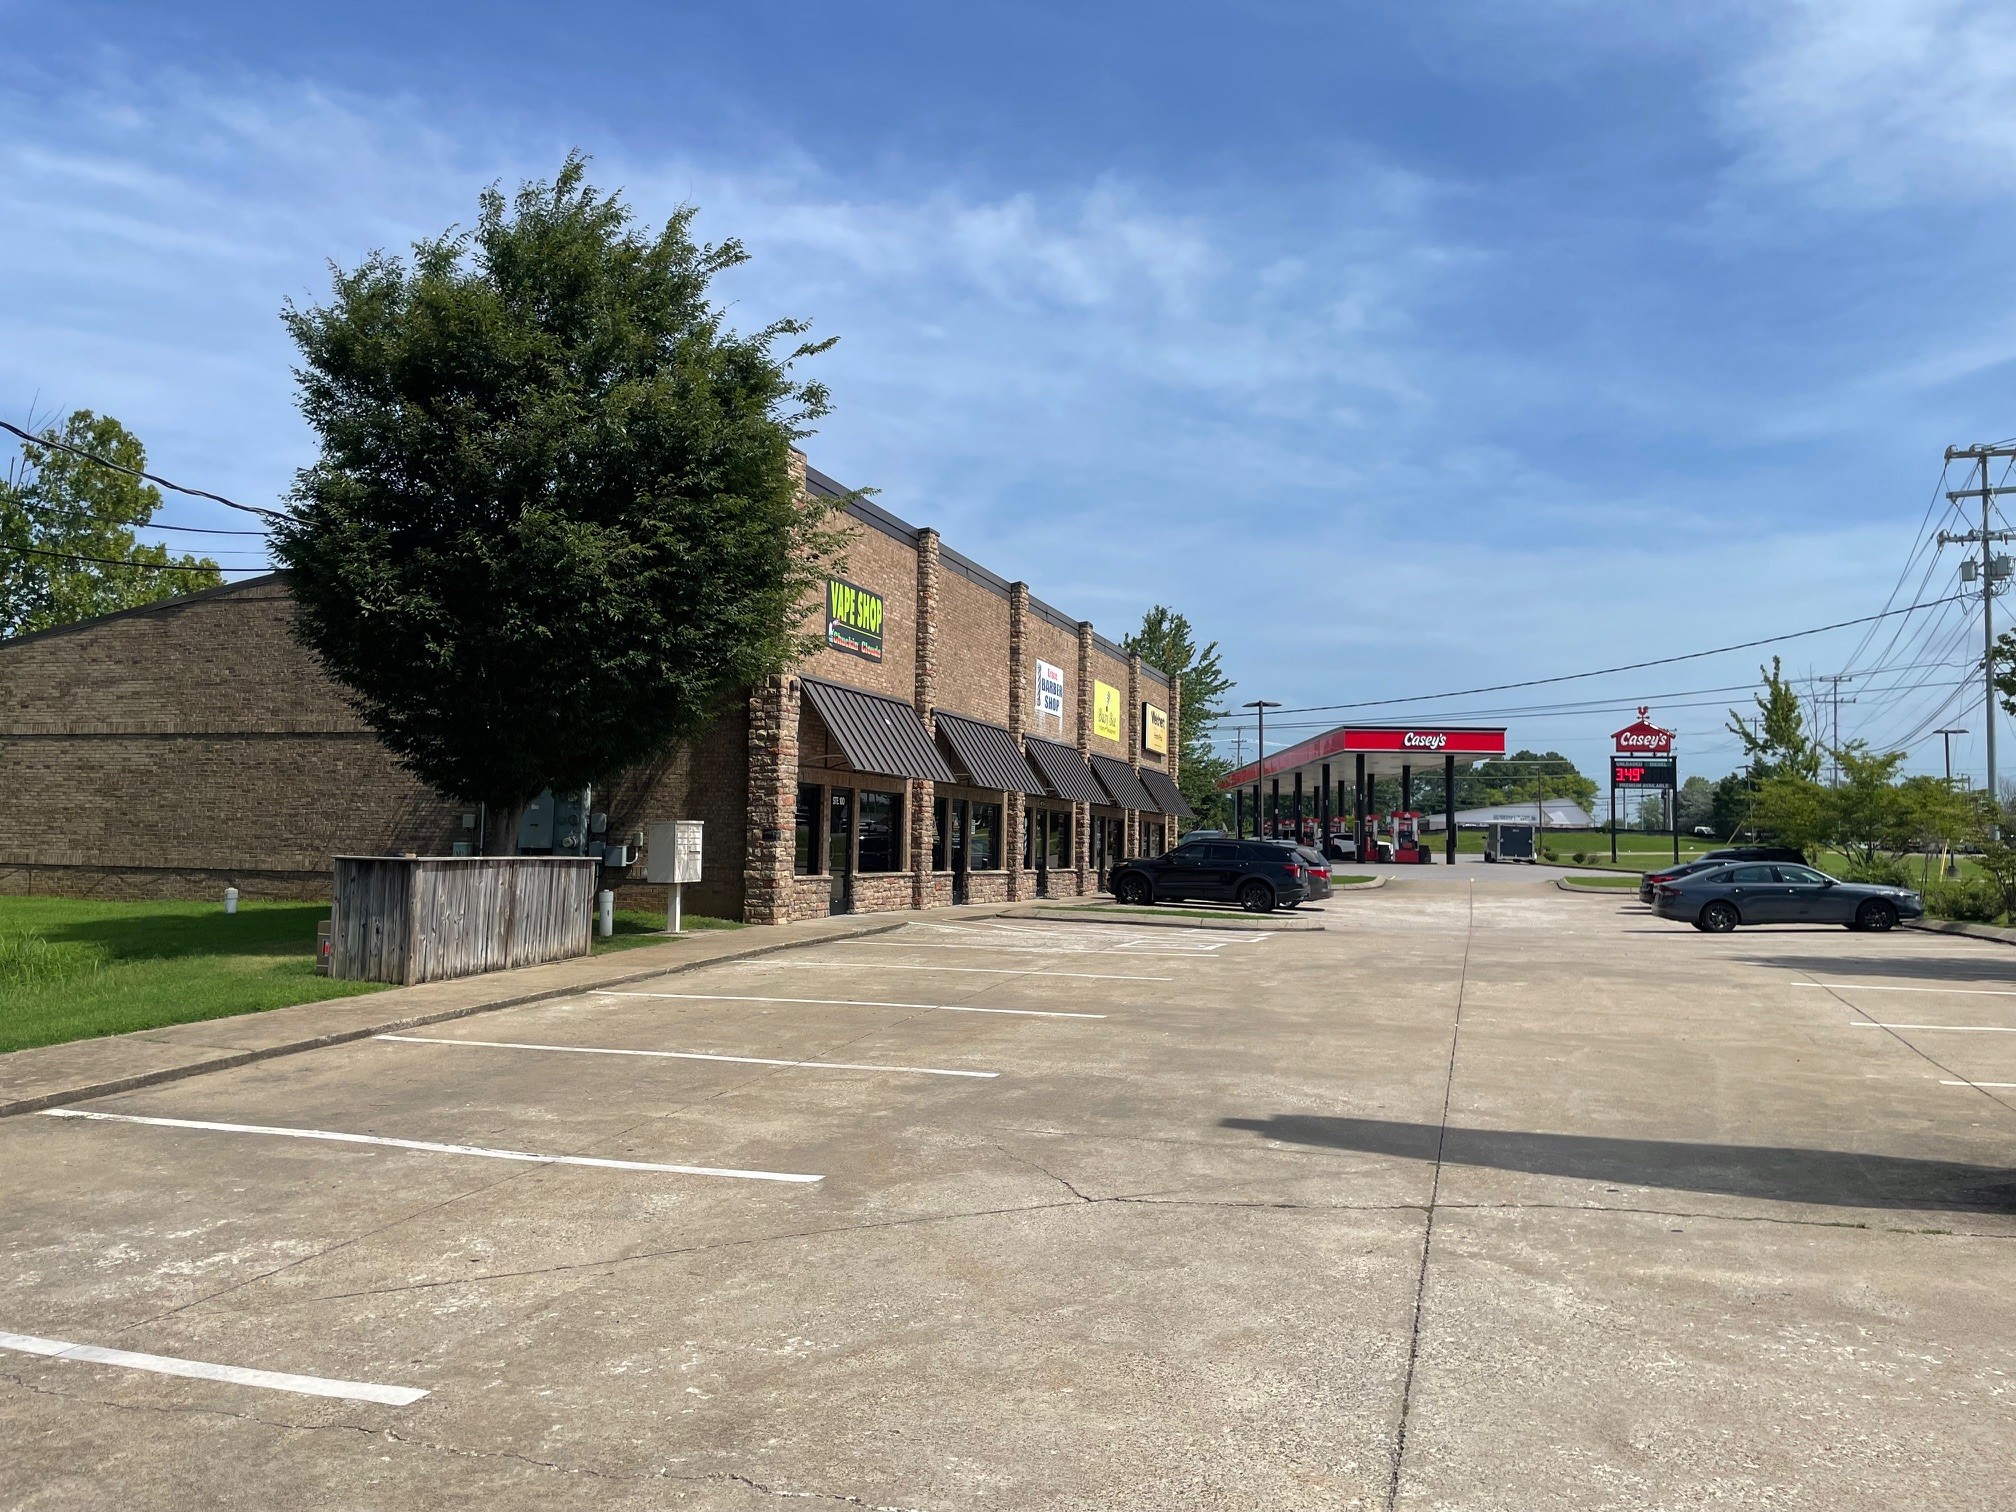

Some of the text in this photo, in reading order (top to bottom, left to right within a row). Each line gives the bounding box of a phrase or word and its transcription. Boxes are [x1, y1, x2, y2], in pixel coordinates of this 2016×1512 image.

[830, 580, 882, 634] VAPE SHOP
[1041, 677, 1063, 698] BARBER
[1044, 694, 1060, 712] SHOP
[1404, 732, 1447, 749] Casey's
[1620, 732, 1667, 749] Casey's
